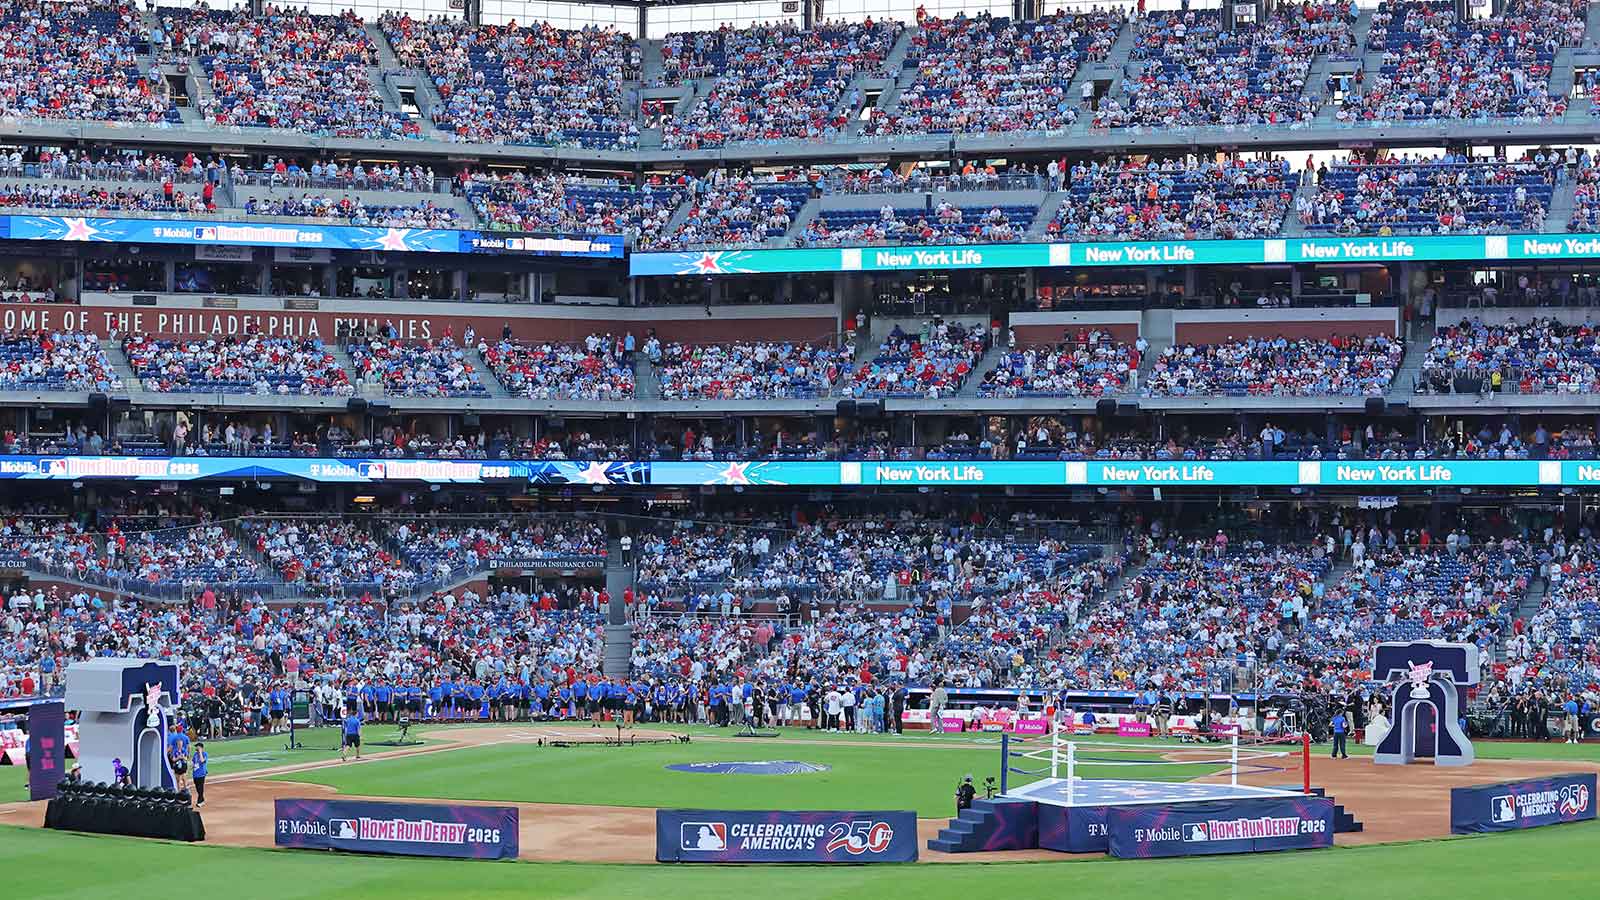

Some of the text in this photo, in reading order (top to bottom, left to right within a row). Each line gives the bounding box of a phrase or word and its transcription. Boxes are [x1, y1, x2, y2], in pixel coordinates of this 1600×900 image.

[163, 228, 192, 238] Mobile
[480, 239, 504, 248] Mobile
[1302, 241, 1414, 258] New York Life
[1524, 239, 1562, 255] New
[876, 250, 982, 266] New York Life
[1085, 245, 1194, 262] New York Life
[64, 311, 88, 331] OF
[104, 312, 142, 333] THE
[159, 313, 319, 337] PHILADELPHIA
[335, 318, 430, 339] PHIIES
[170, 463, 199, 474] 2026
[322, 464, 356, 476] Mobile
[876, 466, 984, 481] New York Life
[1103, 465, 1214, 480] New York Life
[1337, 465, 1451, 480] New York Life
[8, 560, 27, 568] CLUB
[499, 560, 604, 568] PHILADELPHIA INSURANCE CLUB
[1515, 790, 1559, 807] CELEBRATING
[1521, 802, 1556, 817] AMERICA'S
[290, 819, 327, 836] Mobile
[468, 828, 500, 843] 2026
[731, 823, 825, 837] CELEBRATING
[1146, 827, 1181, 842] Mobile
[1300, 819, 1326, 834] 2026
[740, 837, 816, 850] AMERICA'S
